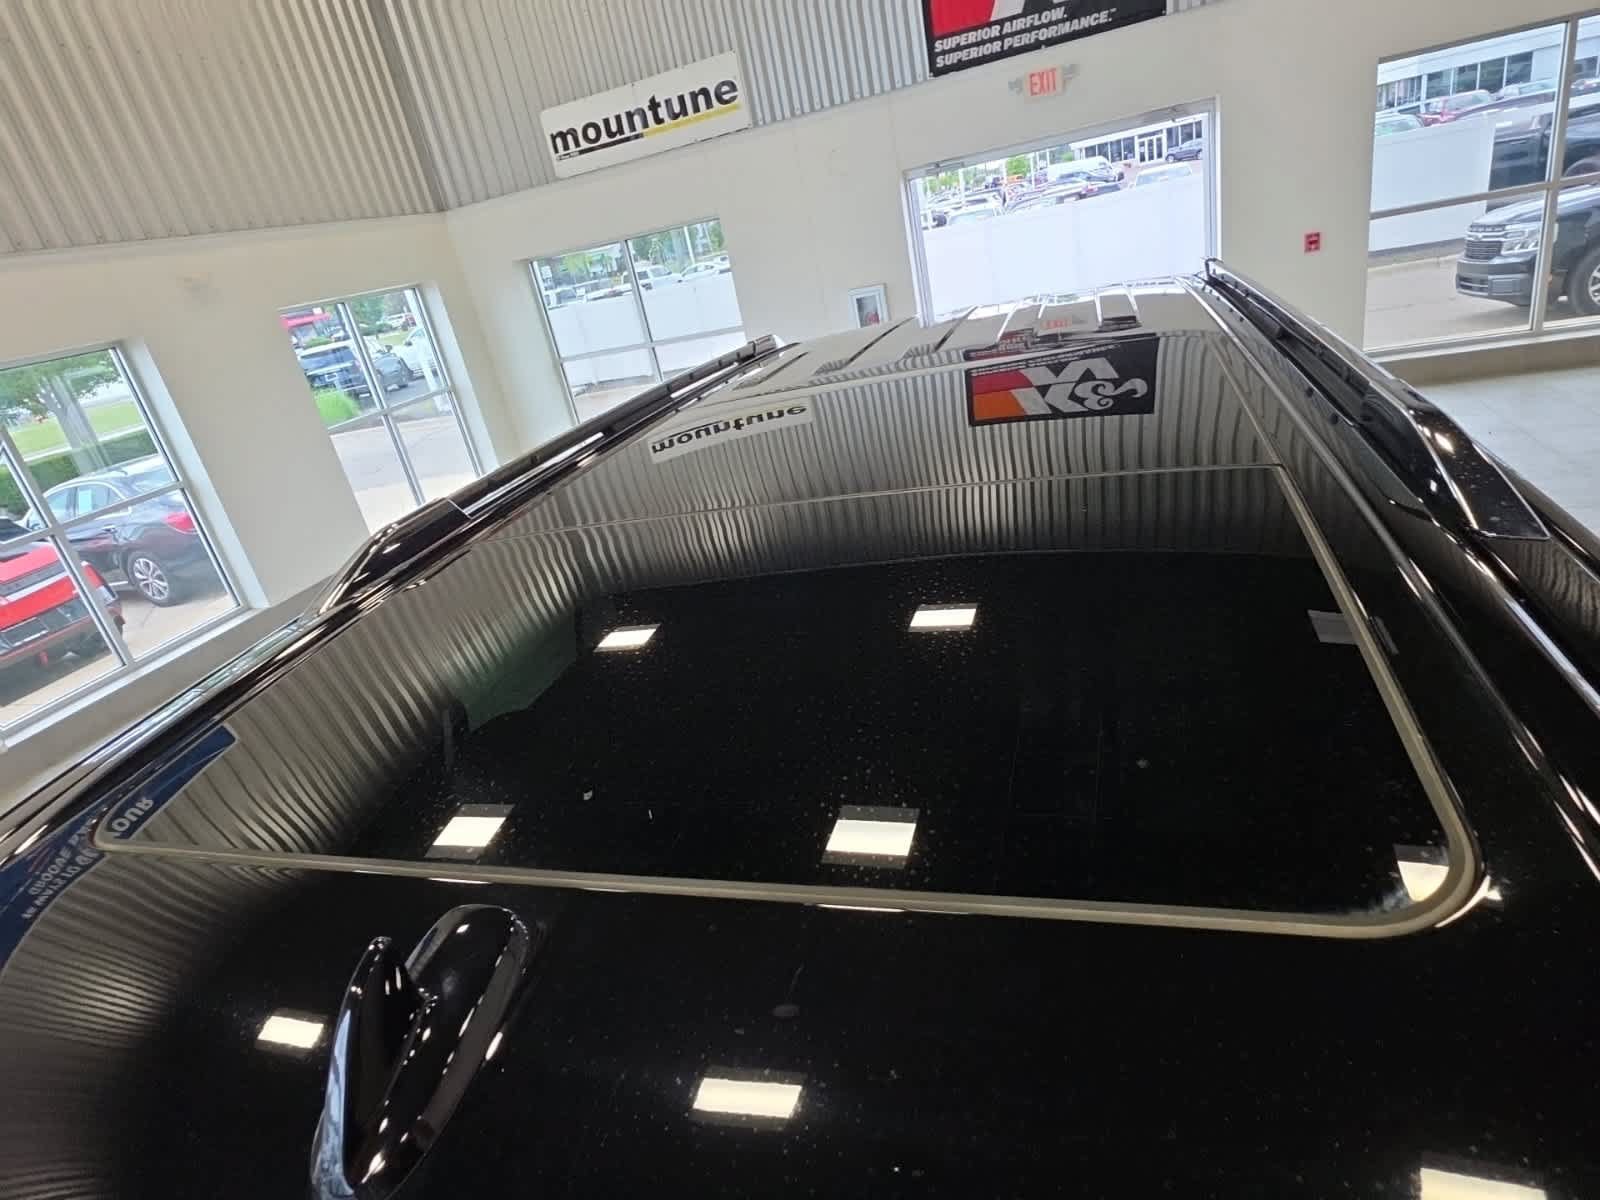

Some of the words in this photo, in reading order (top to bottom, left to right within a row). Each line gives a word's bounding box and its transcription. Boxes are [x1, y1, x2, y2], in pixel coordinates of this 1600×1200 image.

[934, 24, 1001, 52] SUPERIOR
[1002, 6, 1068, 35] AIRFLOW.
[936, 41, 1001, 68] SUPERIOR
[1029, 68, 1057, 96] EXIT
[550, 79, 739, 154] mountune
